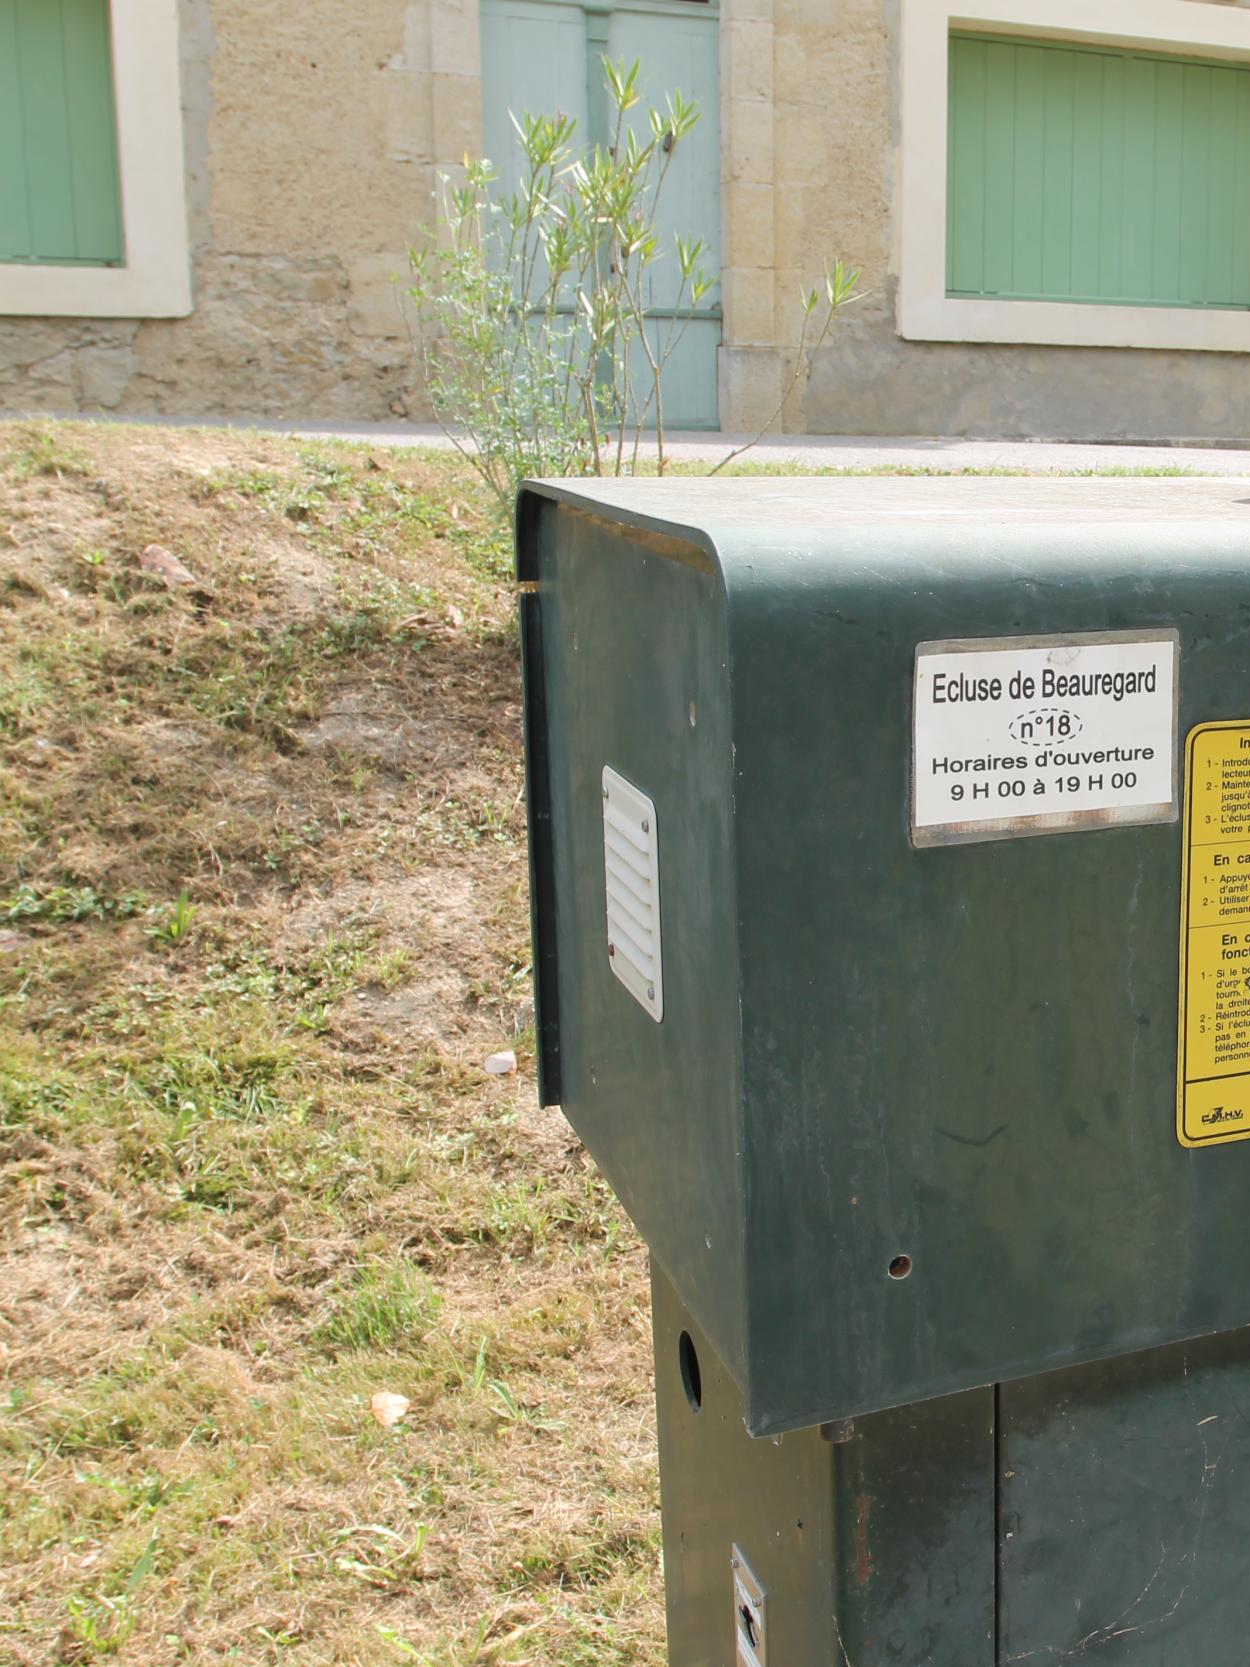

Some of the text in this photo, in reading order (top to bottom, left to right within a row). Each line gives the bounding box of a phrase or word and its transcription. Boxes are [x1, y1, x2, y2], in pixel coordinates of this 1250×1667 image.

[932, 664, 1156, 703] Ecluse de Beauregard
[1021, 715, 1071, 738] n°18
[932, 746, 1154, 774] Horaires d'ouverture
[951, 771, 1137, 801] 9 H 00 à 19 H 00
[1220, 824, 1242, 834] votre
[1214, 855, 1229, 866] En
[1219, 883, 1248, 894] d'arrêt
[1219, 895, 1249, 904] Utiliser
[1222, 934, 1237, 946] En
[1216, 969, 1224, 978] Si
[1229, 968, 1237, 976] le
[1216, 1001, 1223, 1010] la
[1215, 1022, 1223, 1031] Si
[1215, 1033, 1230, 1043] pas
[1235, 1031, 1246, 1039] en
